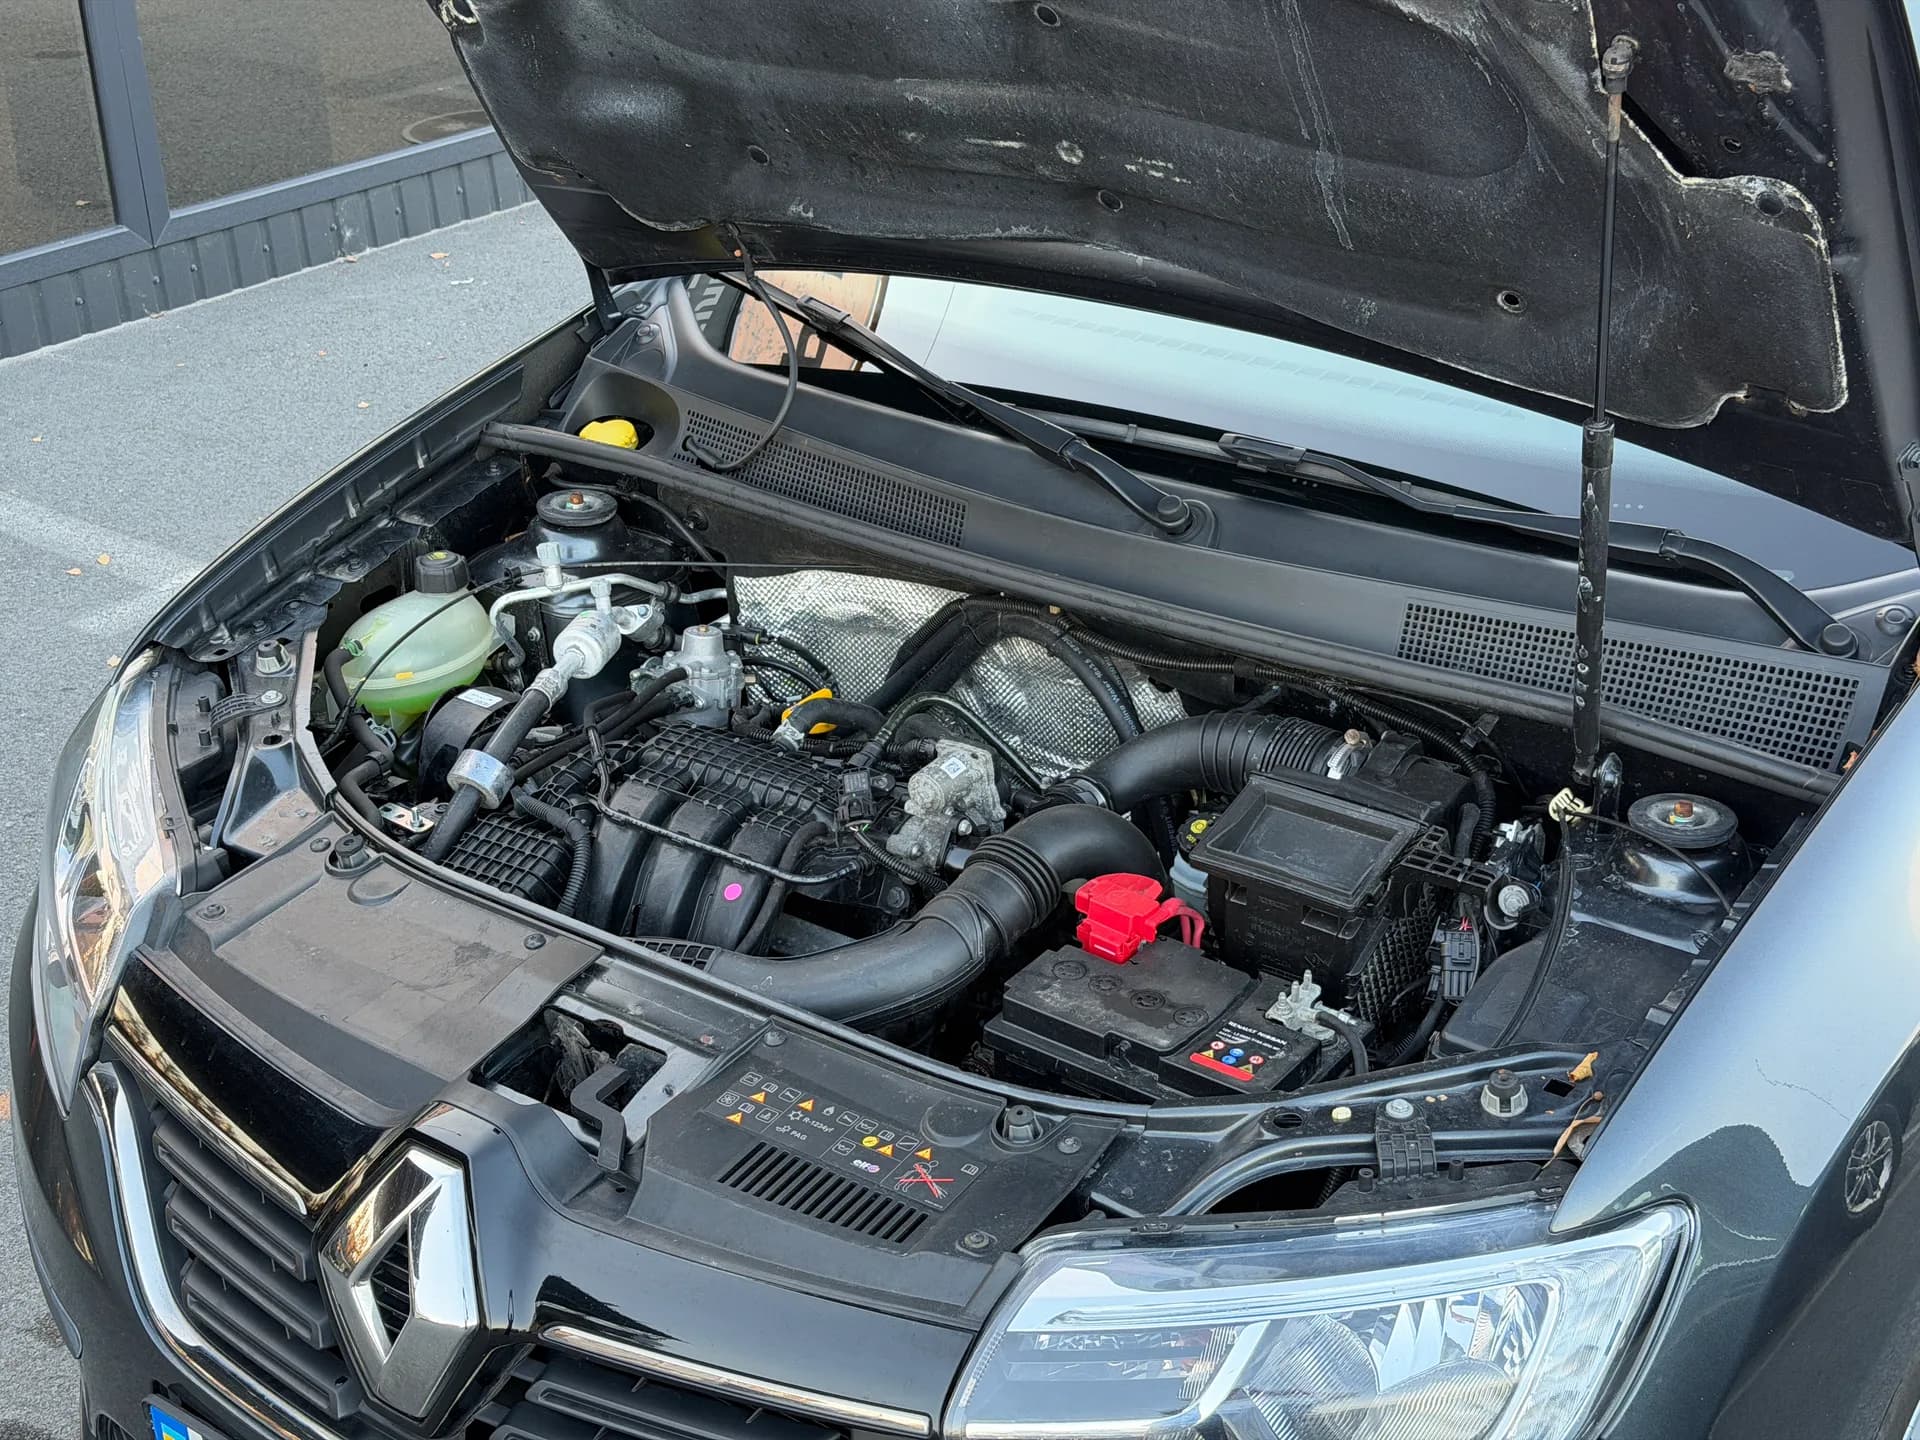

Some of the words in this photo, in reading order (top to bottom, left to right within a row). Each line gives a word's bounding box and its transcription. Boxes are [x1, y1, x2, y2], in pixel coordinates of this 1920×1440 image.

[1103, 680, 1120, 704] Water
[1228, 1021, 1257, 1034] RENAULT
[1257, 1031, 1288, 1045] NISSAN
[802, 1116, 835, 1133] R-1234yf
[790, 1129, 808, 1141] PAG
